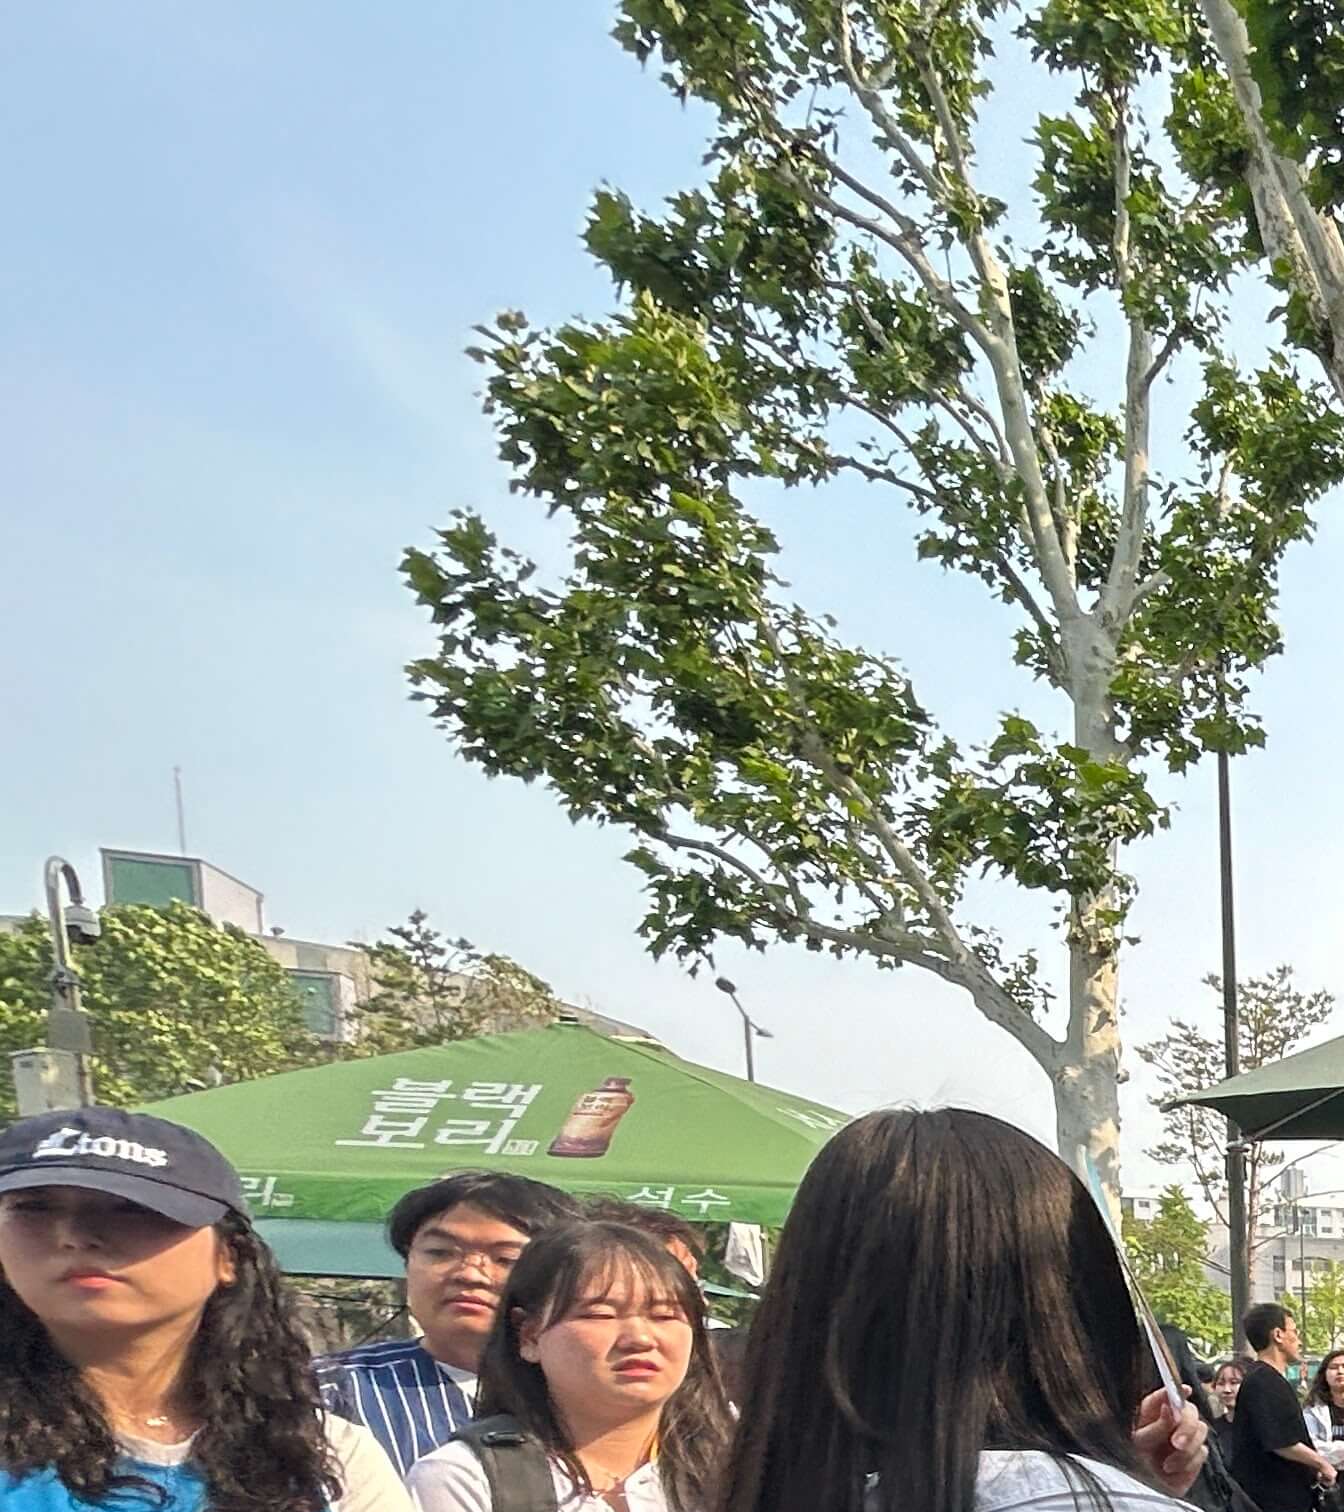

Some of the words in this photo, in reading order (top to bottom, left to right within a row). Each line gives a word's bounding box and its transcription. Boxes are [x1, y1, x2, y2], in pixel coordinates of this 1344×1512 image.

[371, 1077, 543, 1118] 블랙
[32, 1127, 169, 1167] Lions
[335, 1114, 518, 1154] 보리
[626, 1185, 732, 1214] 석수
